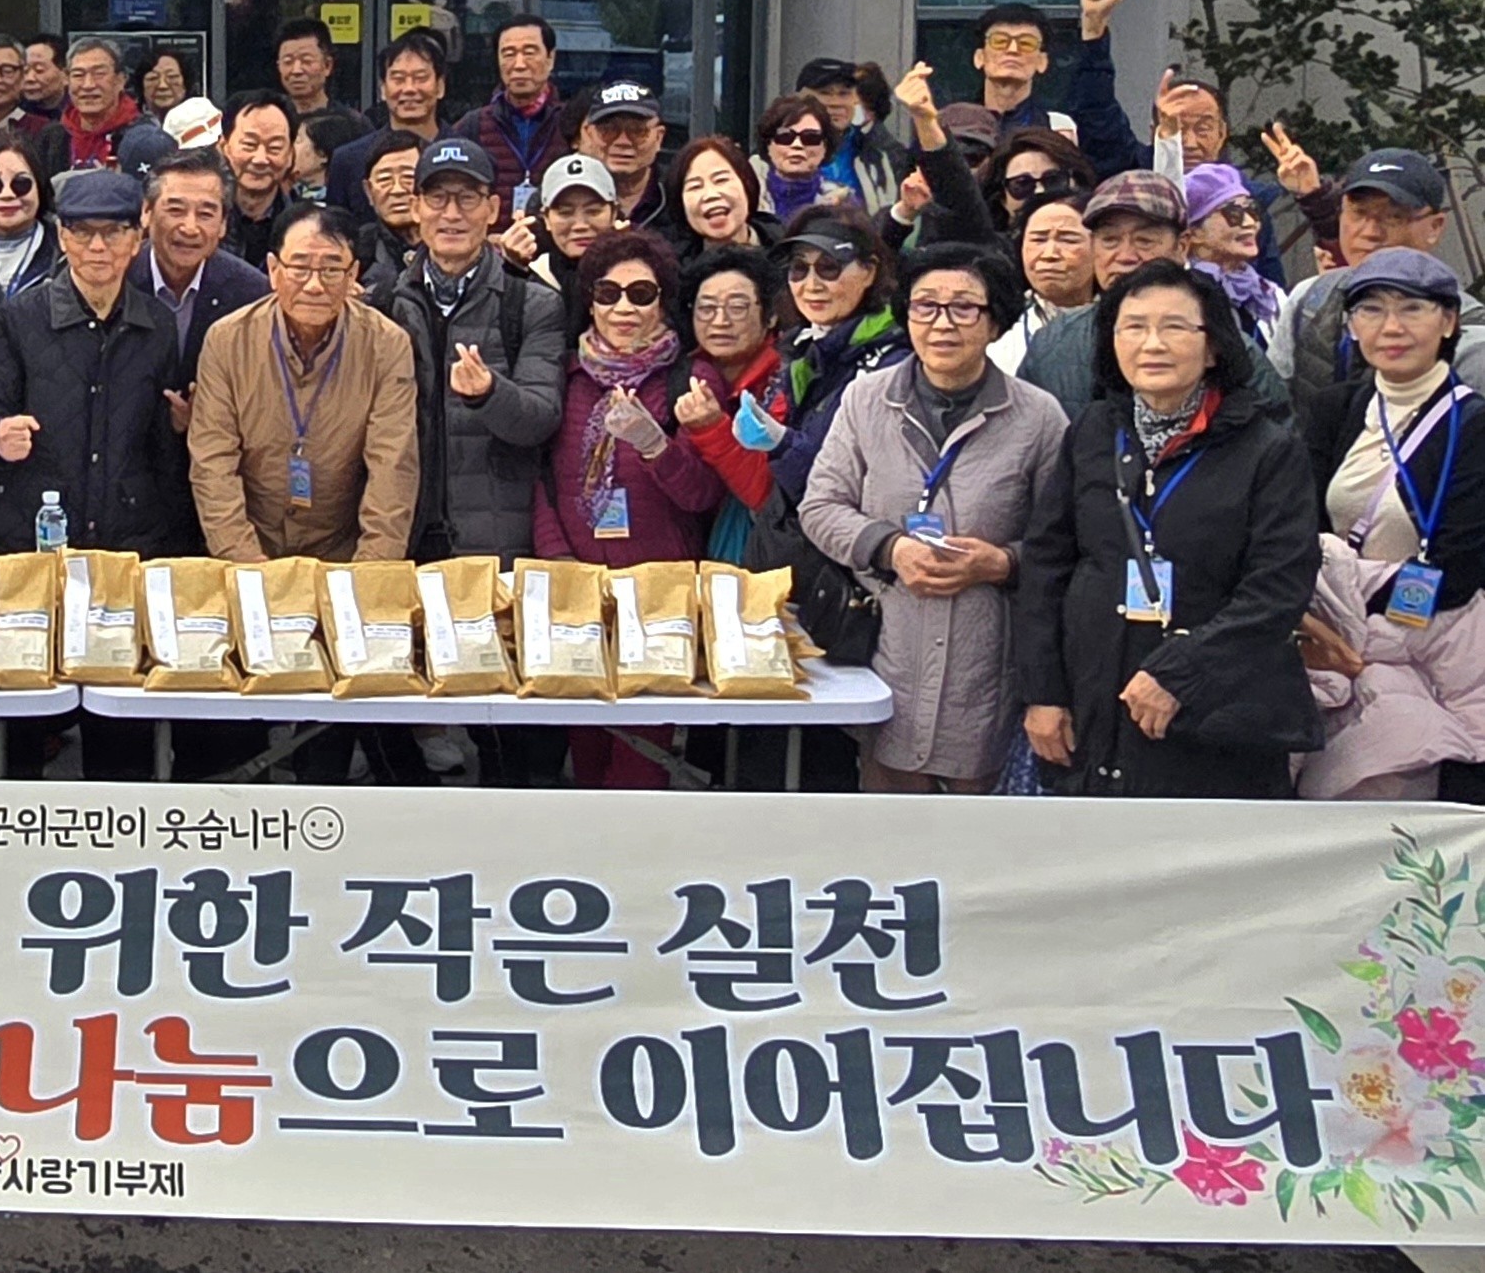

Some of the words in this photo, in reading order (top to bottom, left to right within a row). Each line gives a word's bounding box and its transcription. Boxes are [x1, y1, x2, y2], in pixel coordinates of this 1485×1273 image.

[155, 807, 297, 852] 웃습니다
[20, 867, 310, 999] 위한
[340, 874, 629, 1006] 작은
[657, 878, 948, 1012] 실천
[600, 1024, 1333, 1169] 이어집니다
